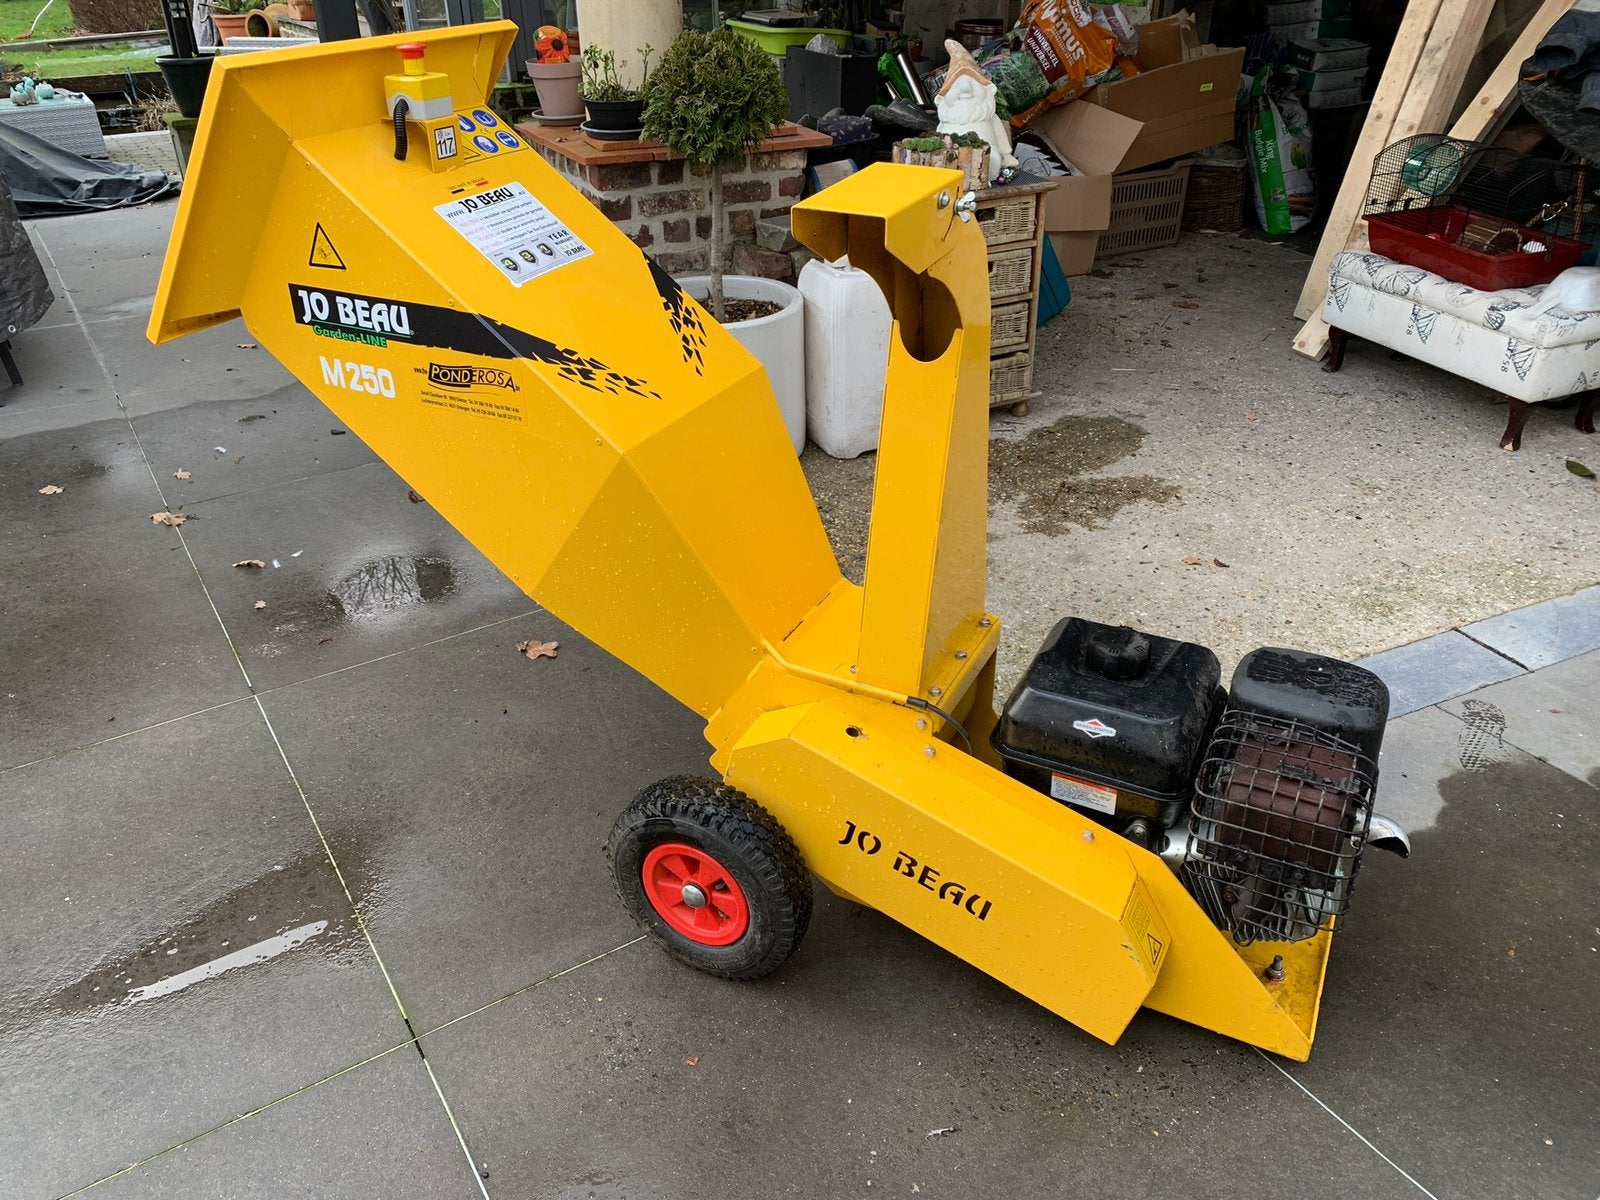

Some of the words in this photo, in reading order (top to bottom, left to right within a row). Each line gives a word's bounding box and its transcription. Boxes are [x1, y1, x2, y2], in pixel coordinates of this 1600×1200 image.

[1027, 37, 1051, 71] UNIVERSEL
[1033, 29, 1059, 67] UNIVERSEEL
[437, 137, 454, 155] 117
[1265, 139, 1275, 160] King
[1257, 157, 1267, 173] Mix
[458, 199, 478, 213] JO
[476, 187, 515, 206] BEAU
[547, 229, 570, 241] YEAR
[504, 258, 514, 267] 4
[540, 244, 548, 252] 1
[298, 289, 330, 324] JO
[335, 295, 411, 335] BEAU
[313, 324, 388, 348] Garden-LINE
[430, 364, 517, 393] PONDEROSA
[838, 820, 882, 855] JO
[892, 850, 993, 921] BEAU
